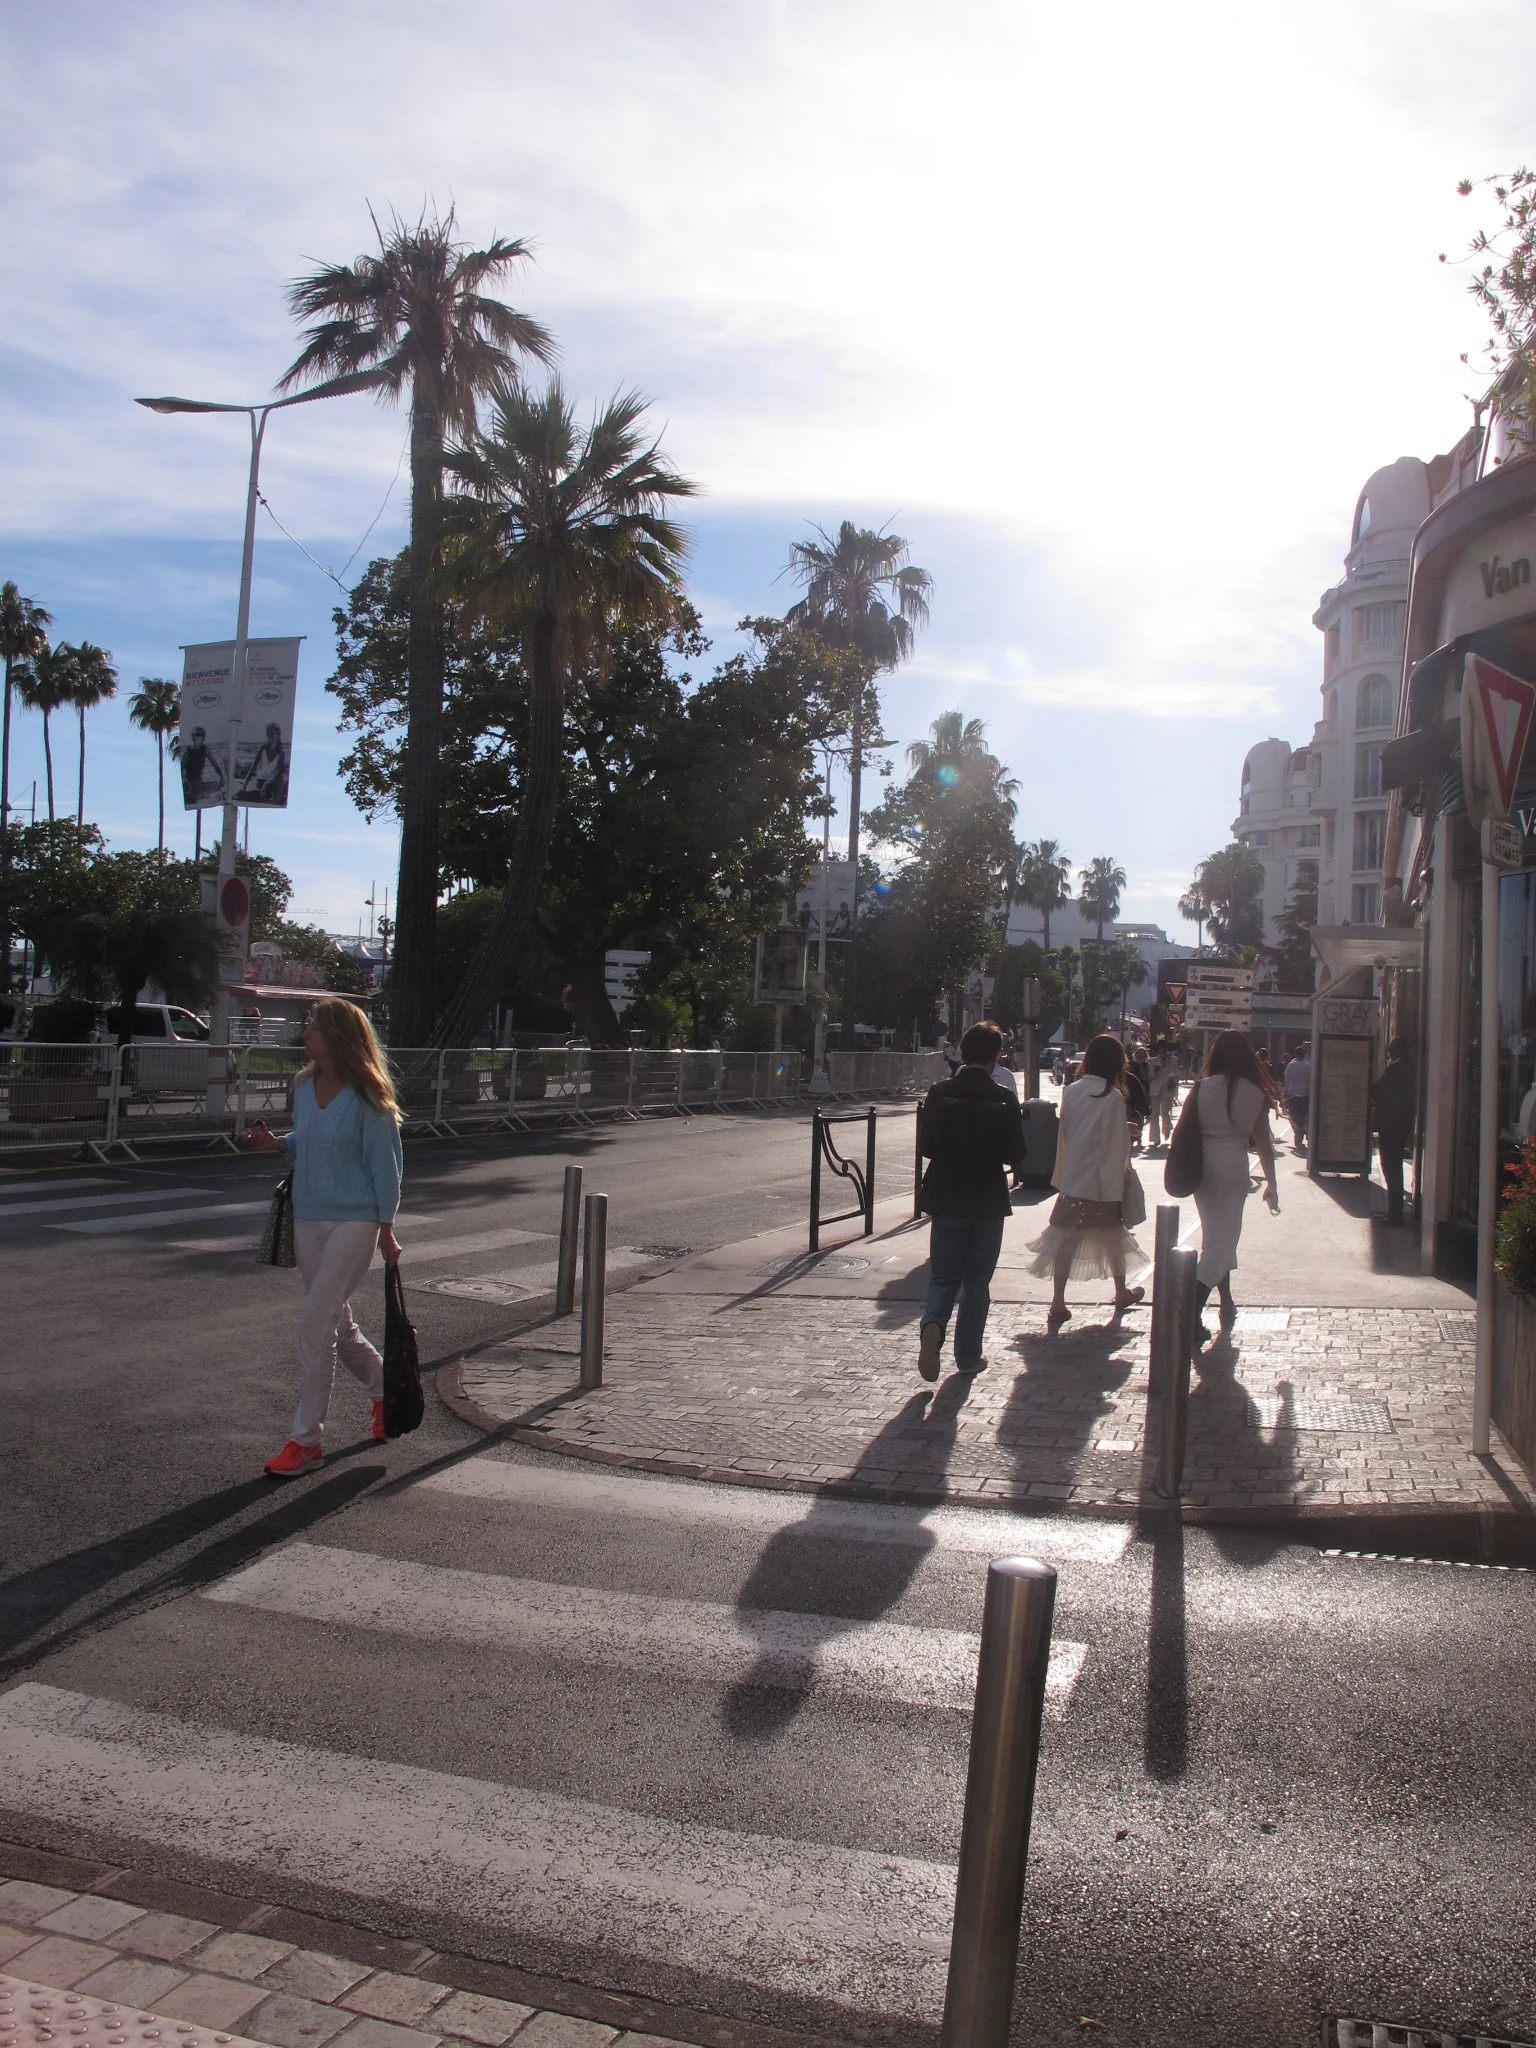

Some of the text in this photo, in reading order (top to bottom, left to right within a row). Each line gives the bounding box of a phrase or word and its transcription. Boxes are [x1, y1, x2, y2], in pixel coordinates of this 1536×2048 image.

[1477, 556, 1530, 598] Van
[185, 677, 225, 687] WELCOME
[186, 668, 231, 680] BIENVENUE
[1517, 807, 1536, 837] V
[1323, 1003, 1371, 1021] GRAY
